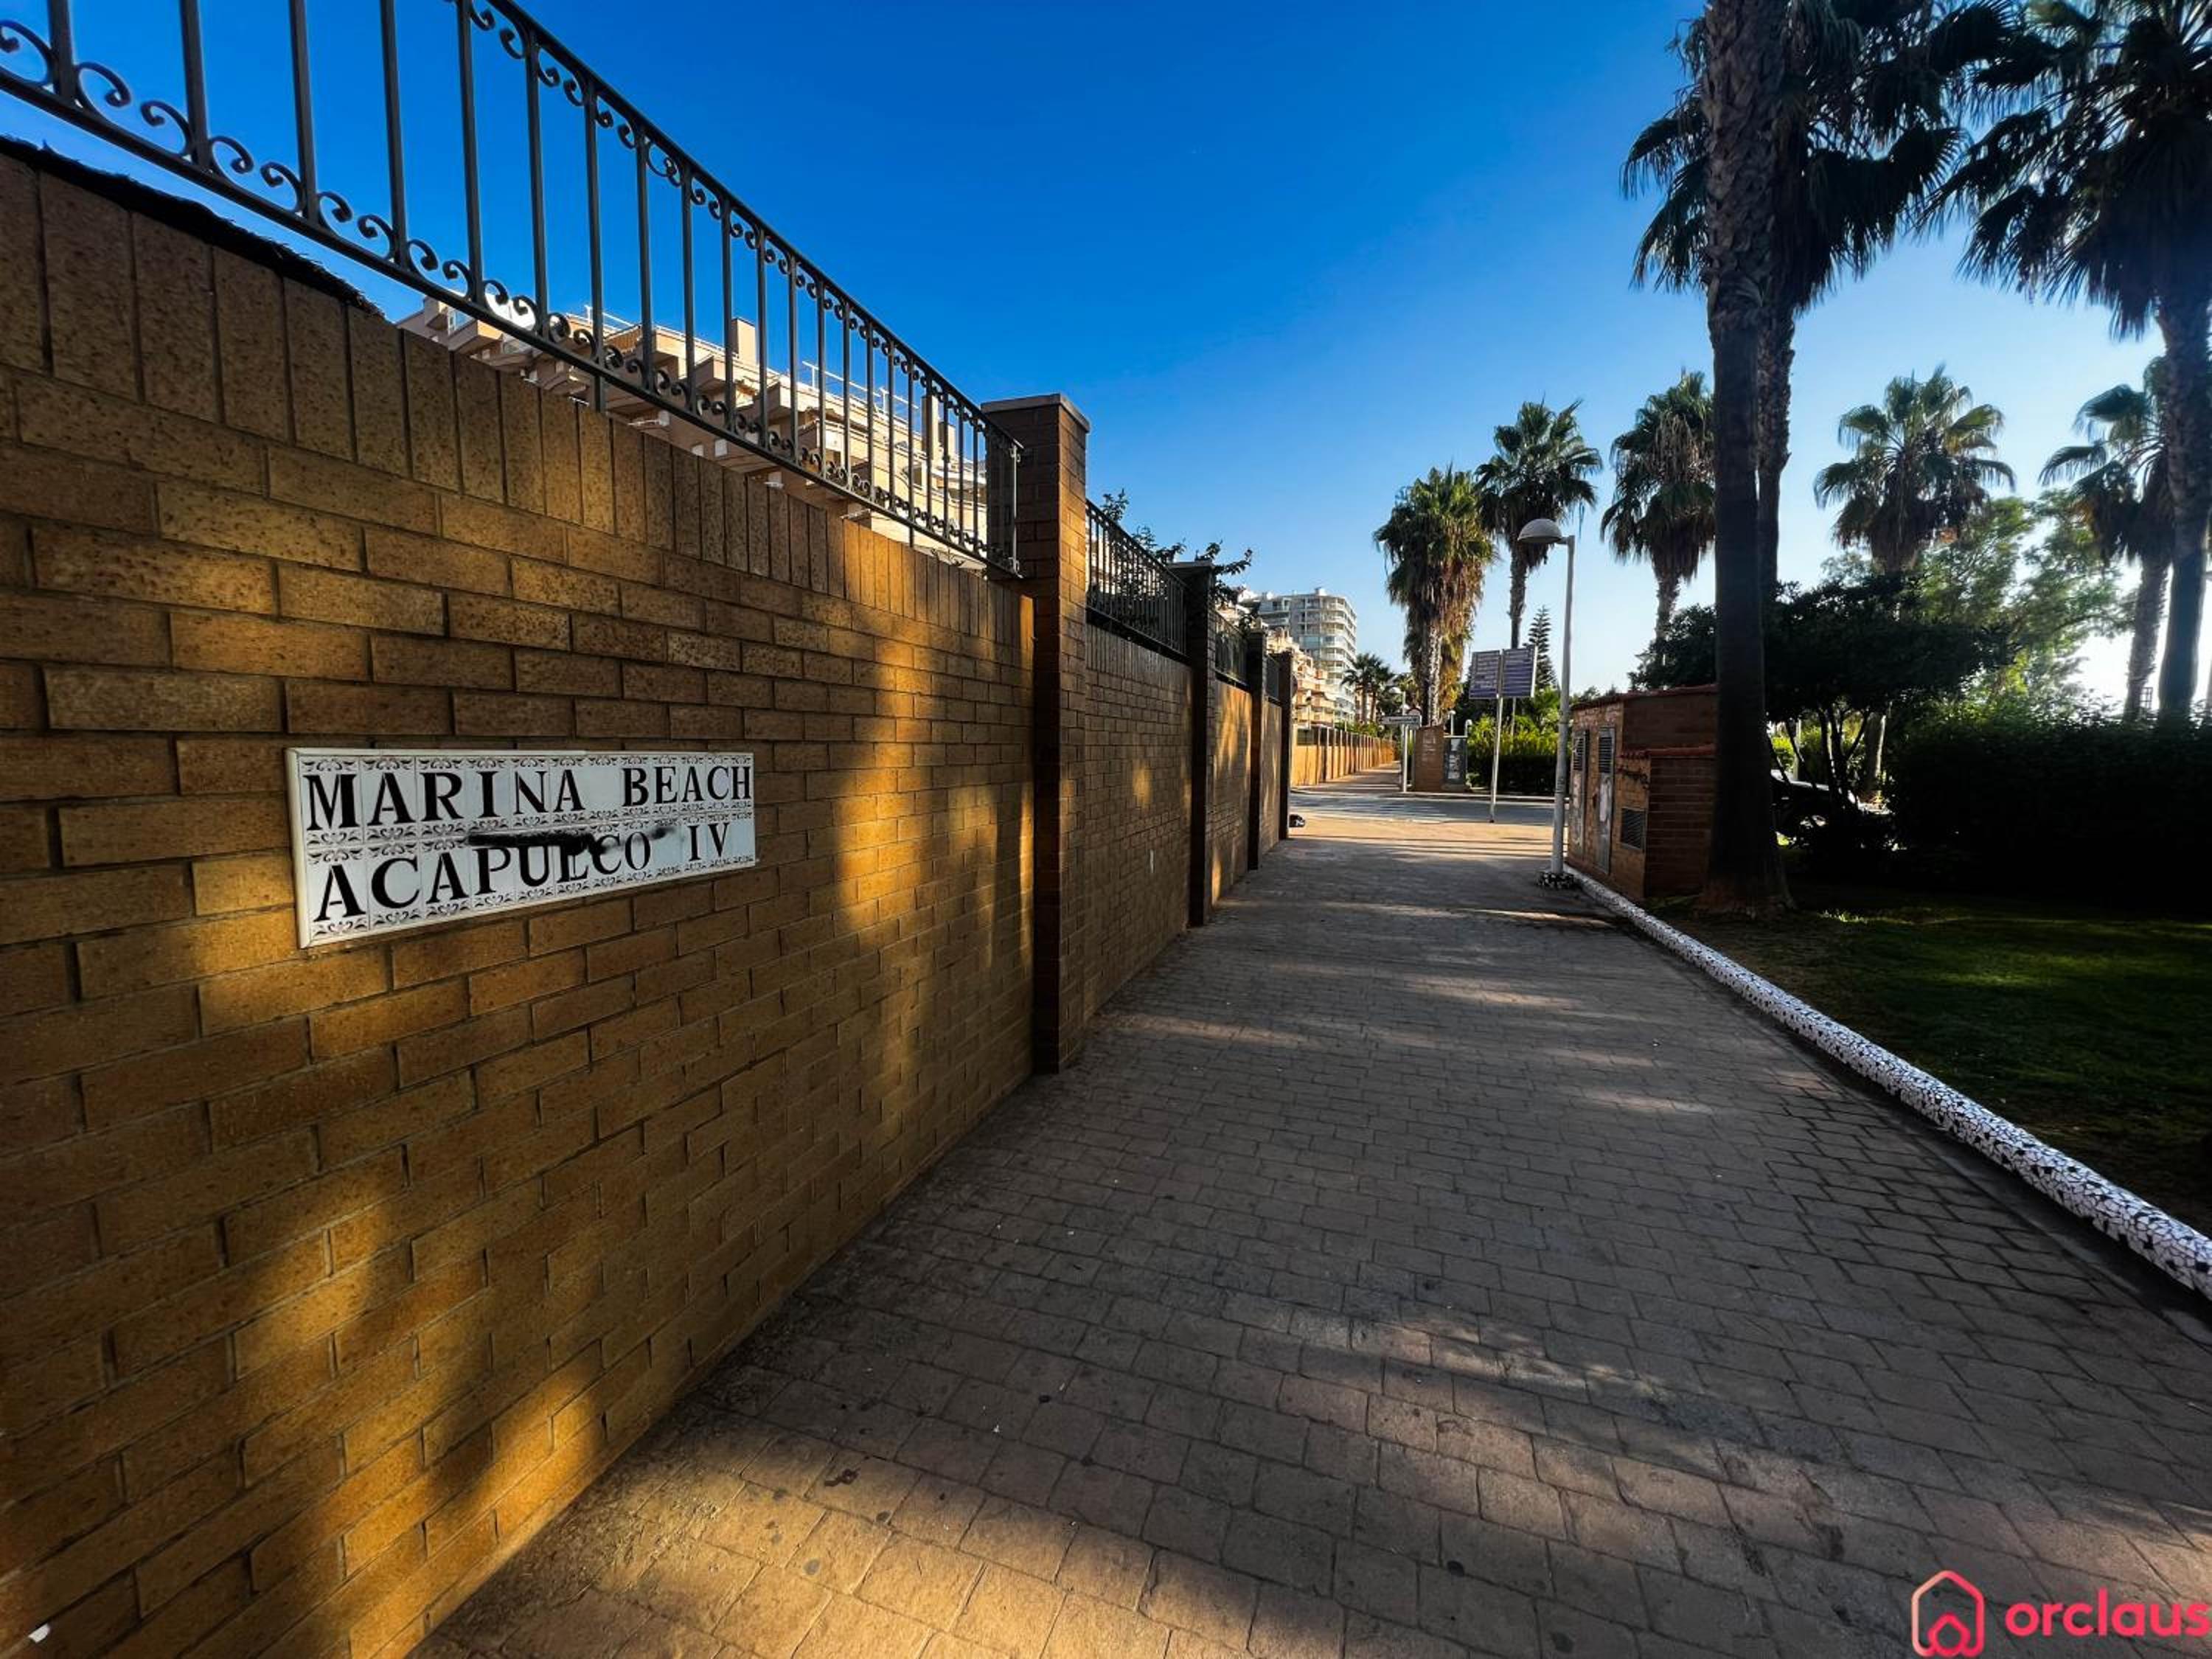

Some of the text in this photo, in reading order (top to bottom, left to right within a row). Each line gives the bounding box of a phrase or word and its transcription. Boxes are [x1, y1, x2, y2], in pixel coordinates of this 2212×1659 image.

[305, 765, 751, 832] MARINA BEACH
[313, 822, 730, 922] ACAPULCO IV
